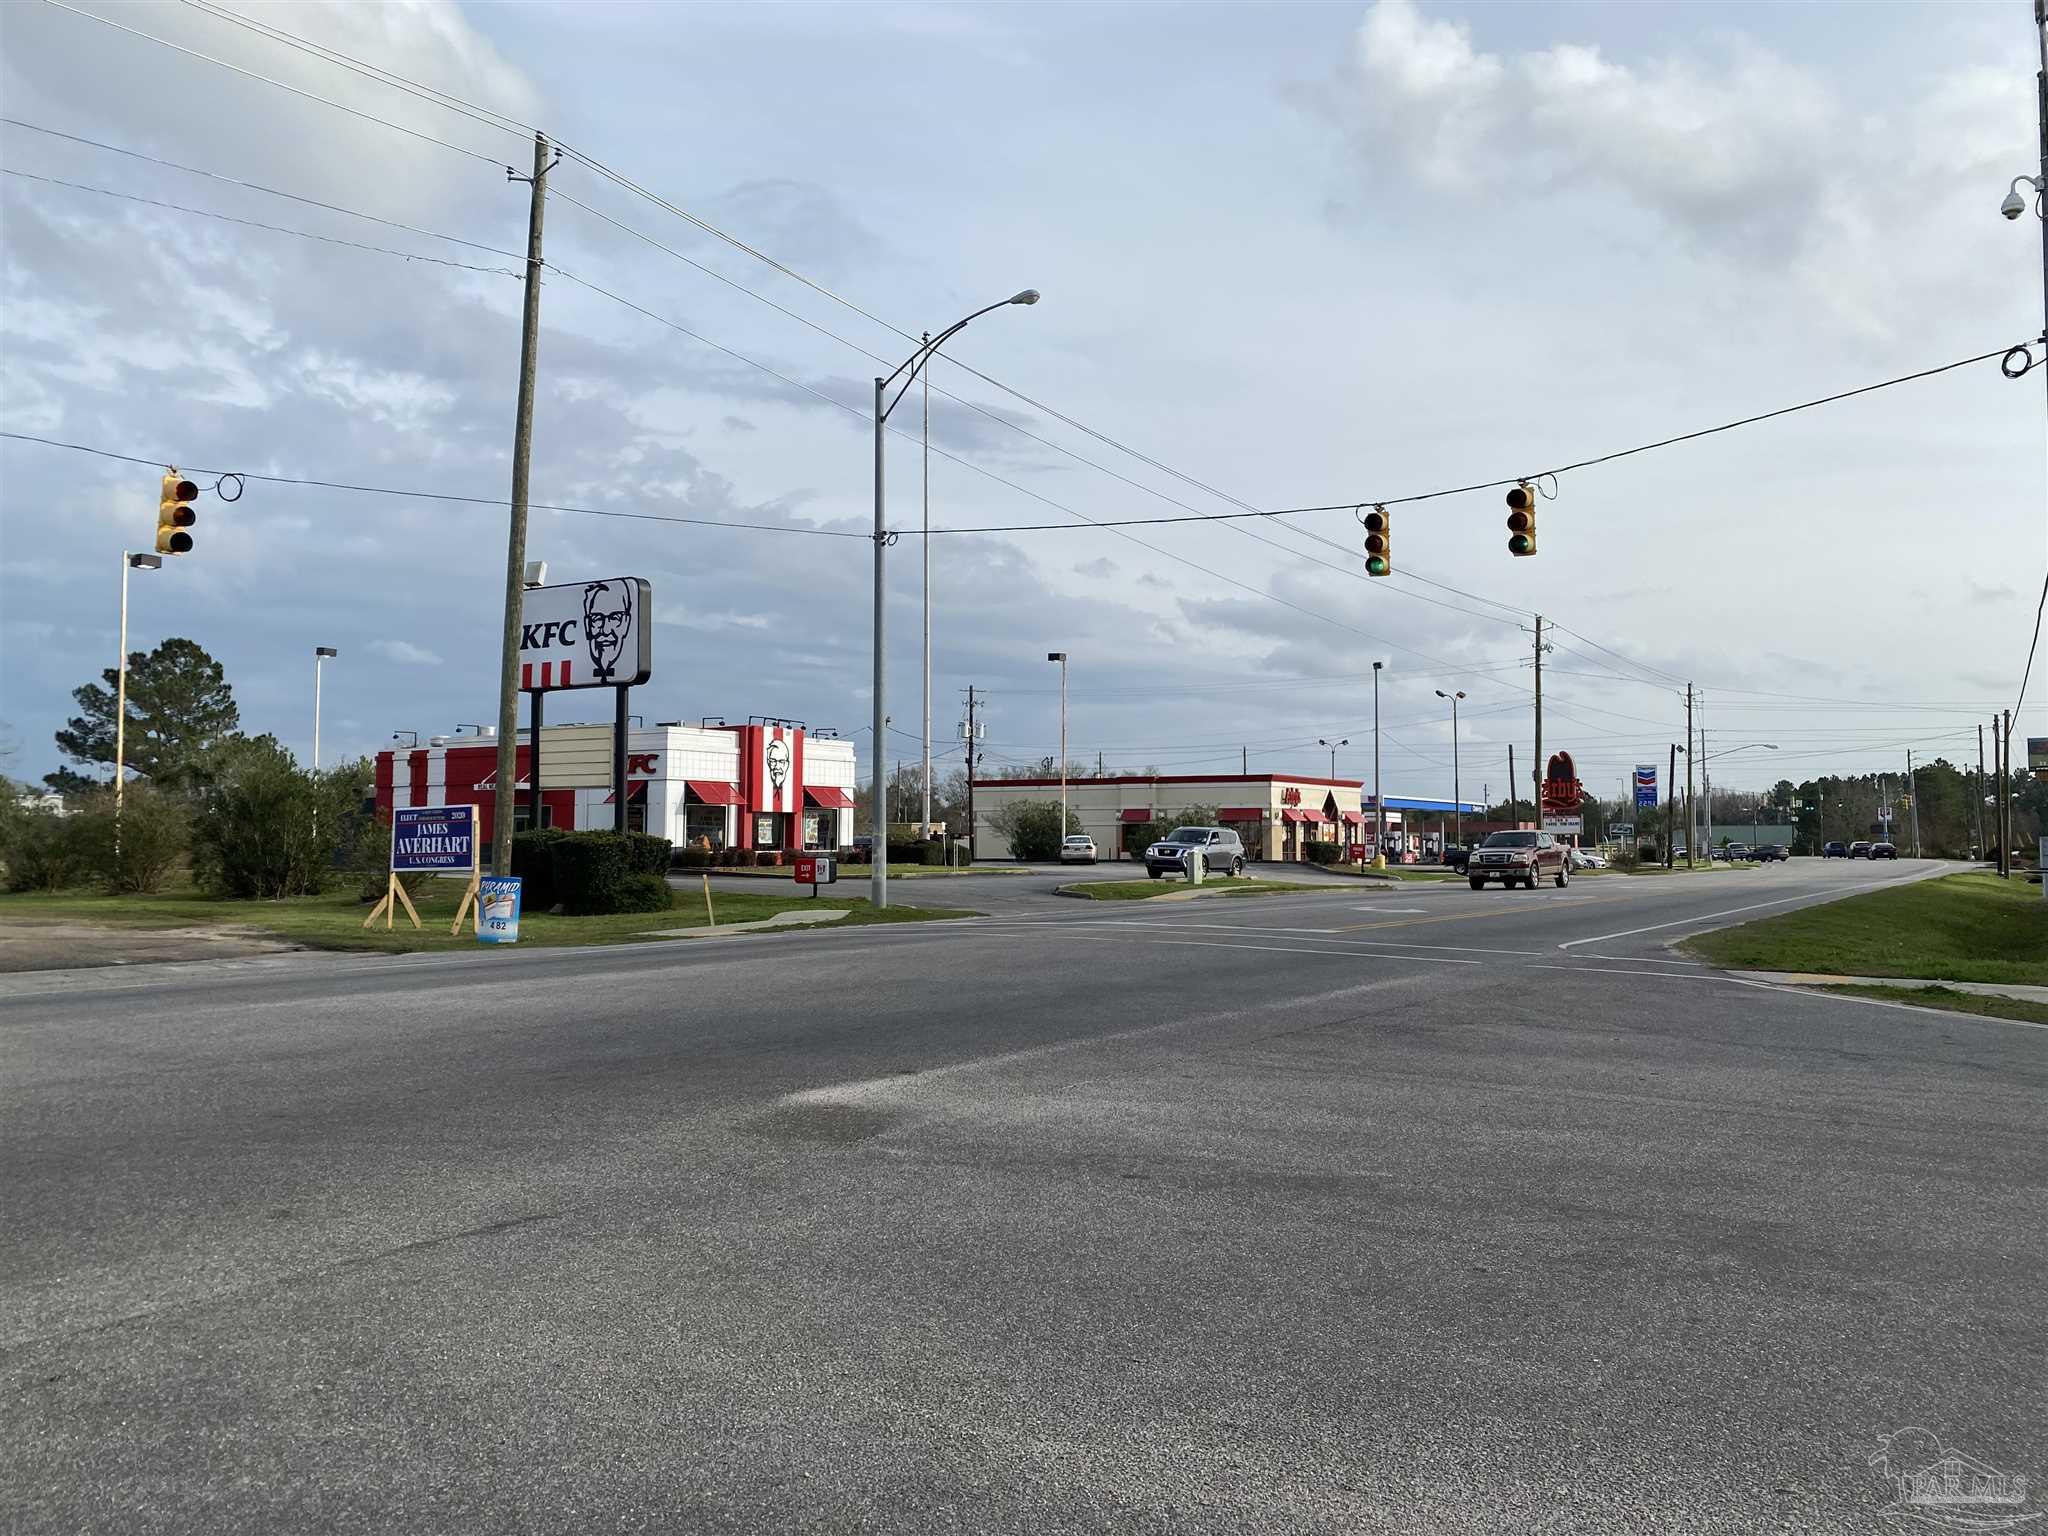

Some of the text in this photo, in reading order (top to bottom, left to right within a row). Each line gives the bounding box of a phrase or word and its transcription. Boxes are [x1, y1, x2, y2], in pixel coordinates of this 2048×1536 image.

[520, 620, 577, 650] KFC
[627, 754, 660, 774] FC
[400, 814, 418, 822] ELECT
[416, 823, 448, 837] JAMES
[396, 836, 470, 855] AVERHART
[421, 855, 455, 864] CONGRESS
[480, 880, 520, 894] PYRAMID
